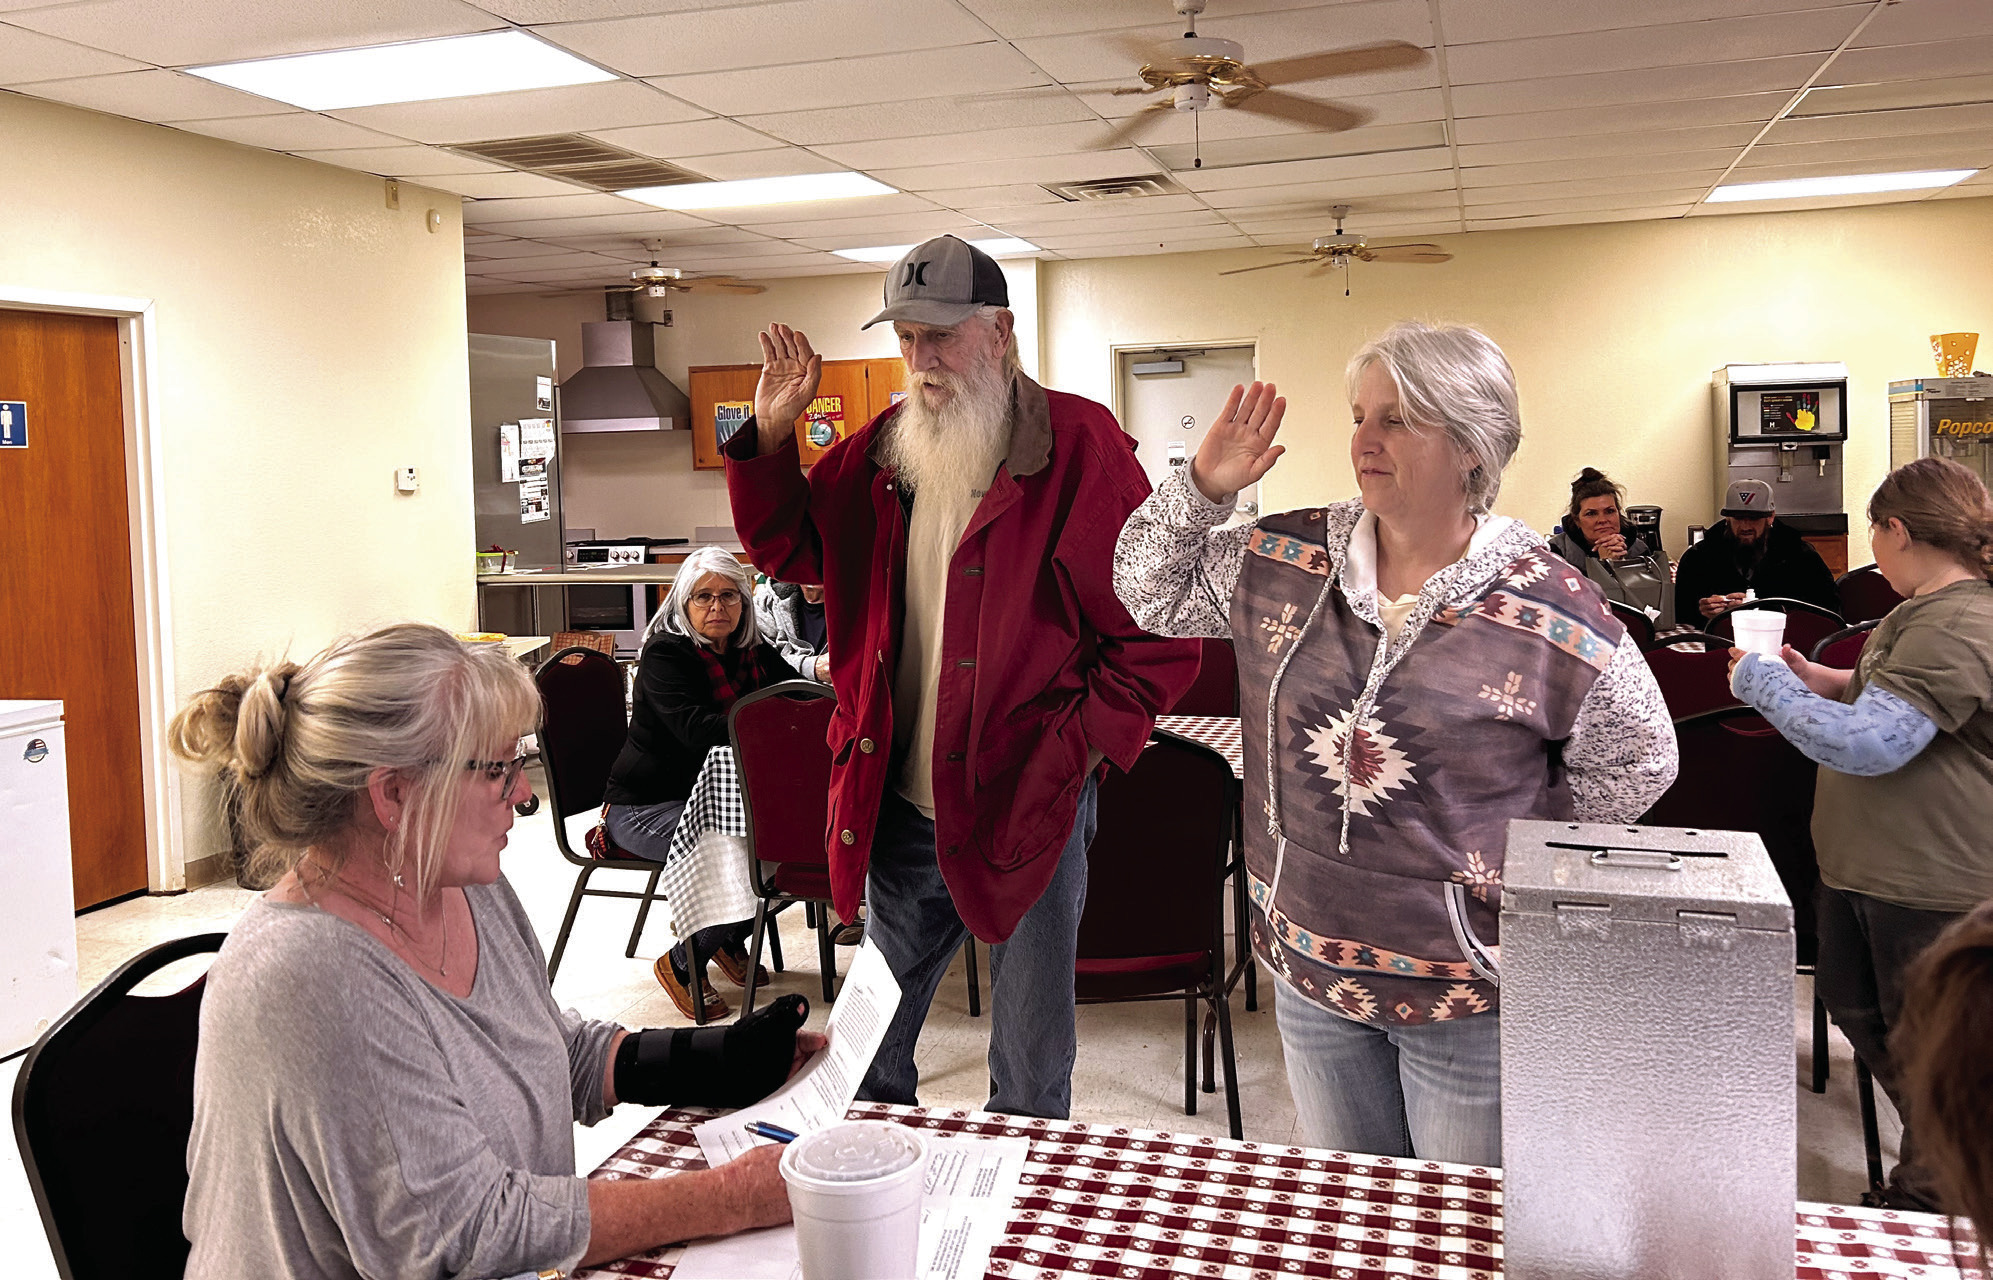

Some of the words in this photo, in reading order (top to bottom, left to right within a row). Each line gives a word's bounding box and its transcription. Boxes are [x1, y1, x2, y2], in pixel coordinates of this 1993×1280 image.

[717, 405, 742, 421] Glove
[743, 404, 751, 420] it
[1936, 419, 1993, 438] Popco
